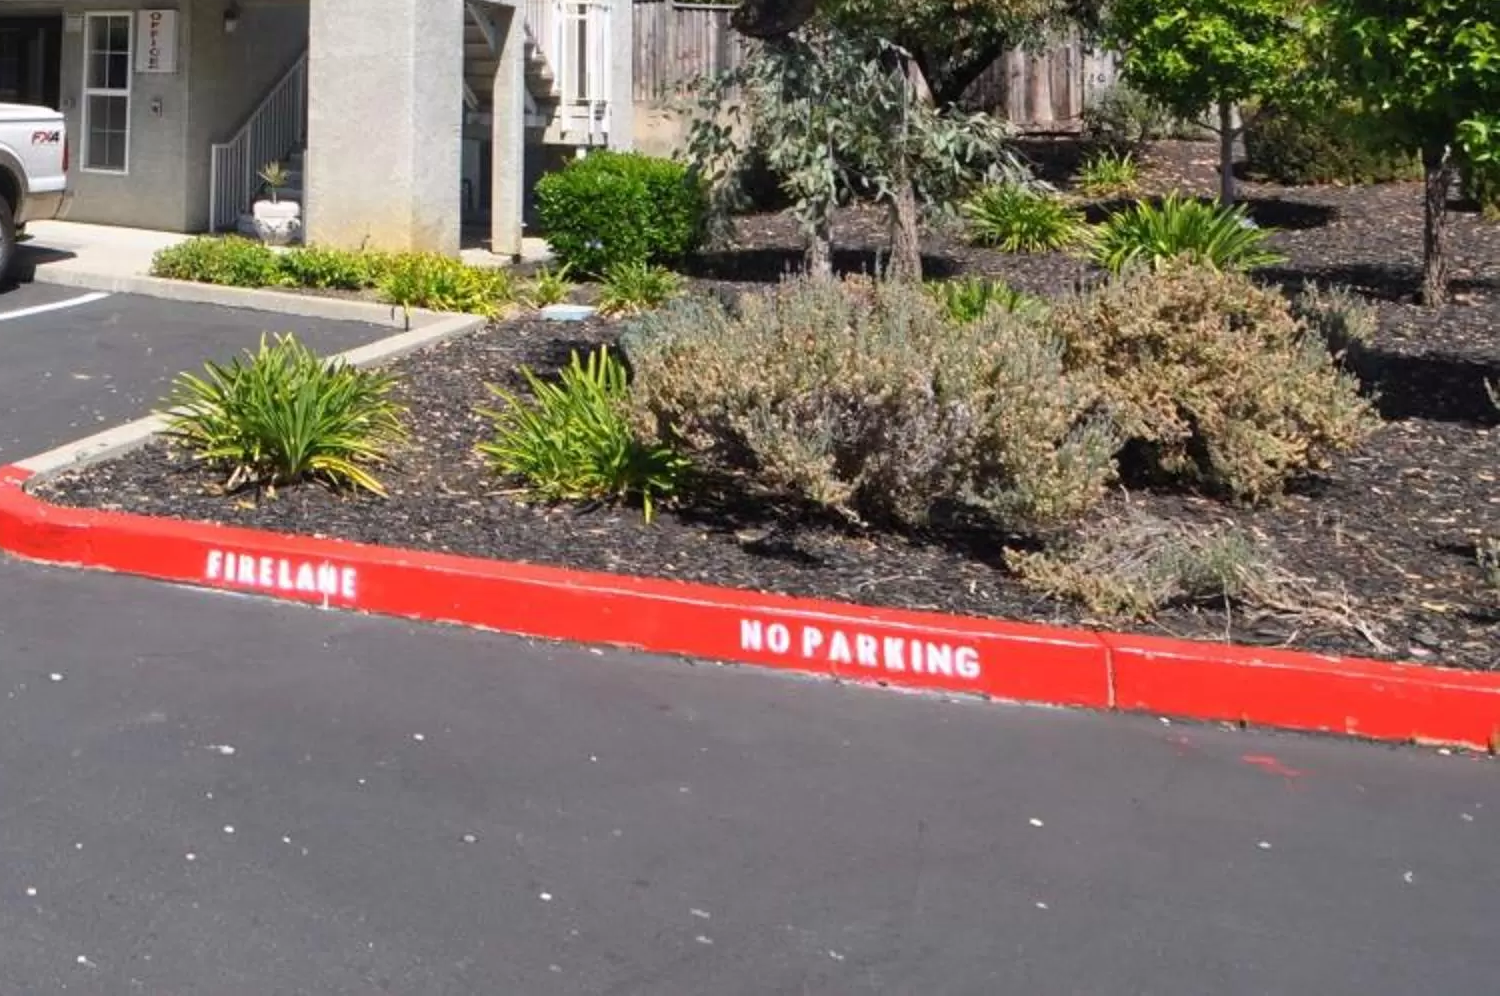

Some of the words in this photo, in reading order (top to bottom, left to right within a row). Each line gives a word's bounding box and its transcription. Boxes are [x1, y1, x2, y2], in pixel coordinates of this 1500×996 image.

[149, 11, 162, 70] OFFICE
[31, 130, 60, 145] FX4
[740, 619, 791, 655] NO
[802, 625, 981, 680] PARKING
